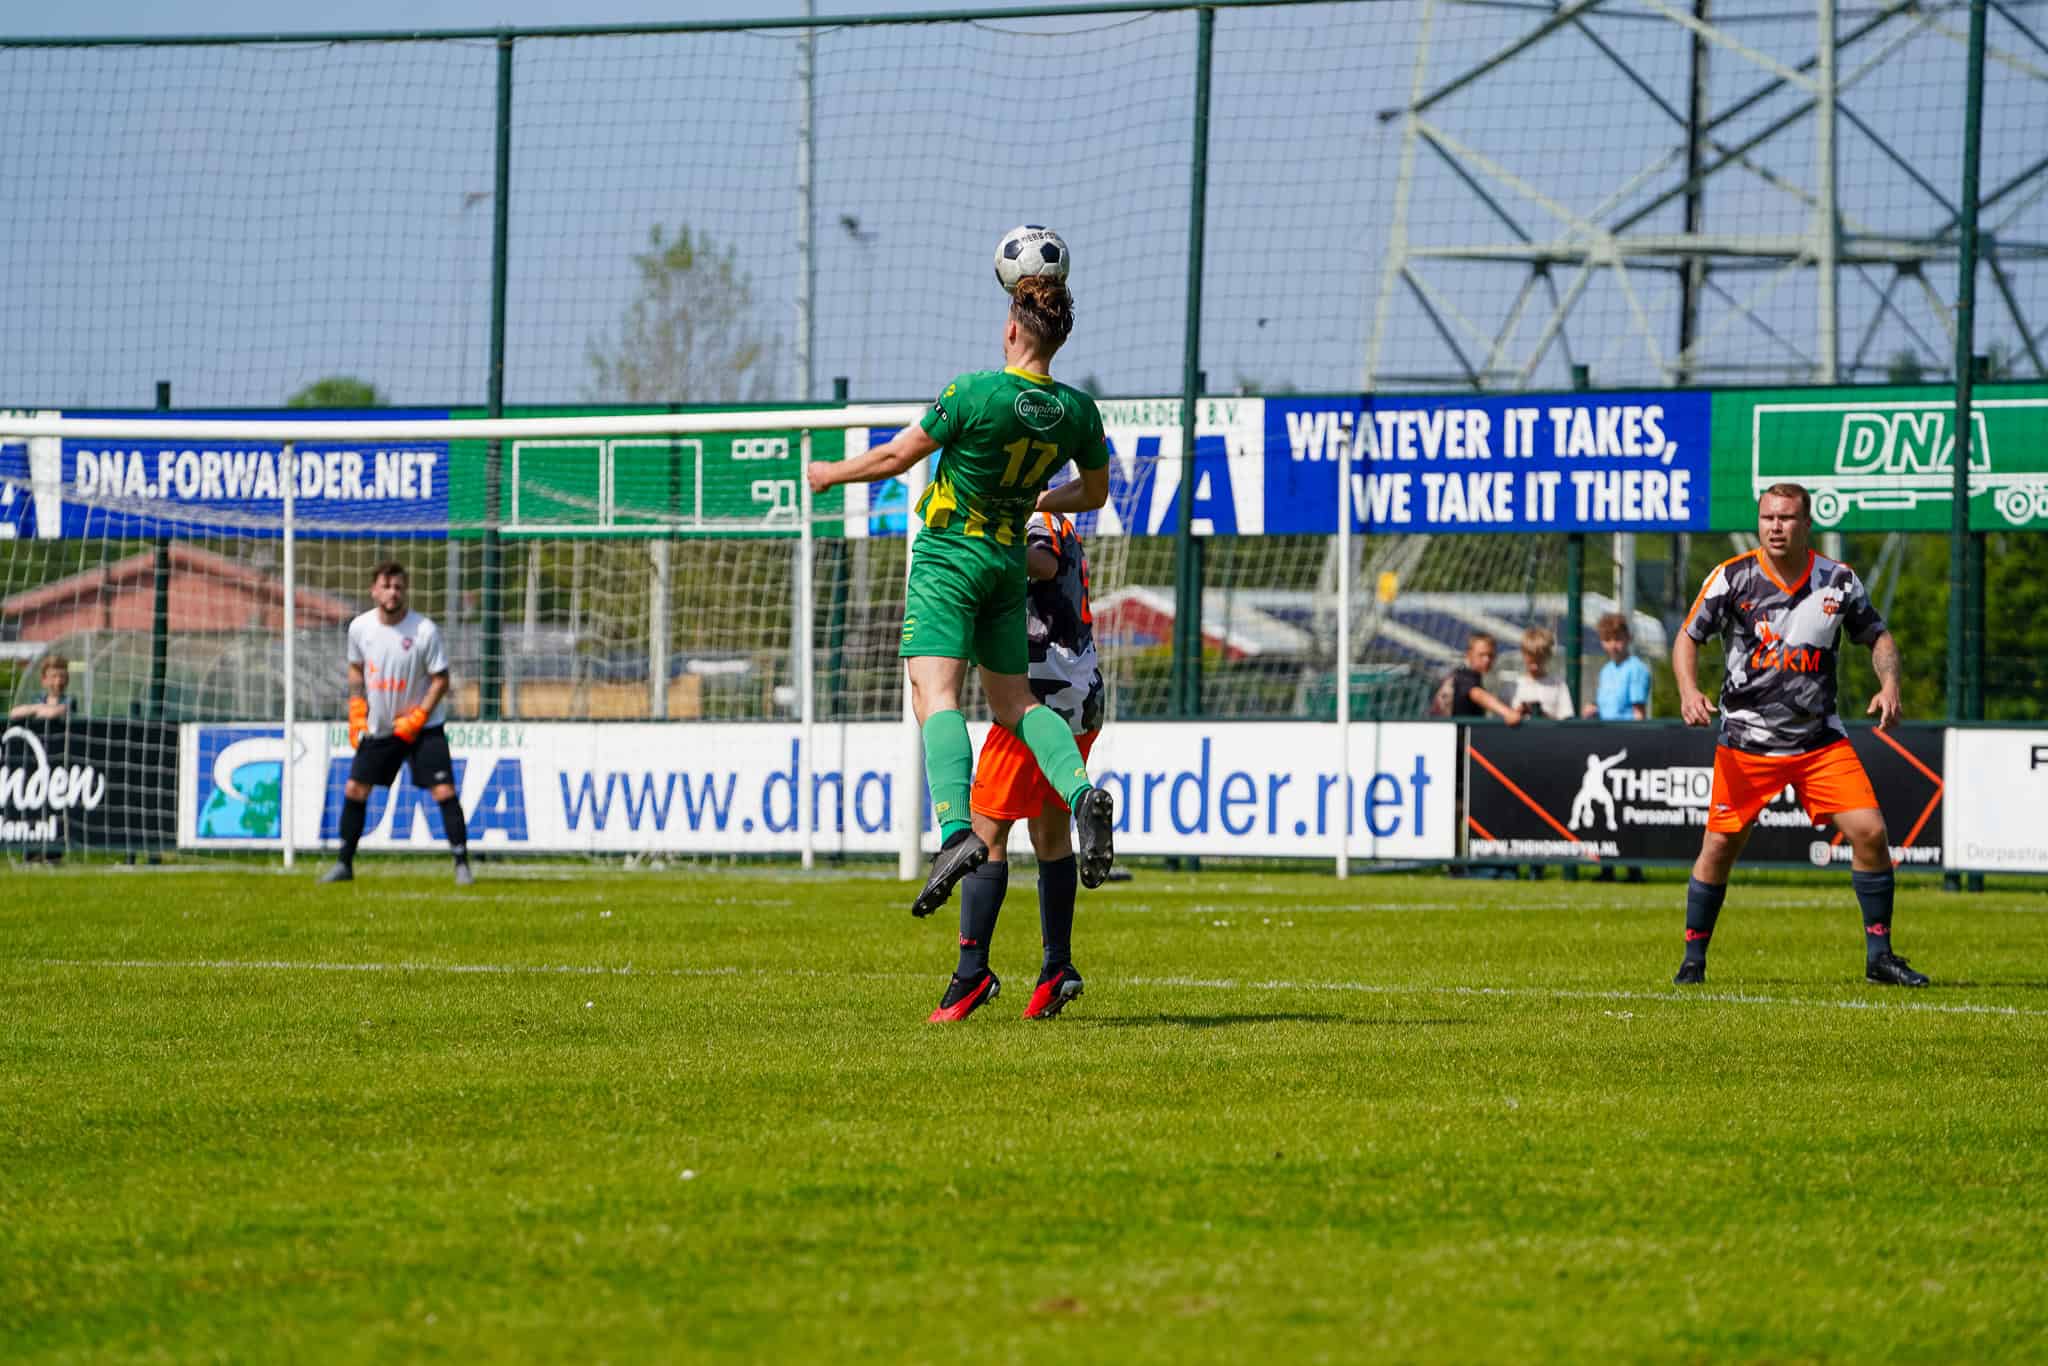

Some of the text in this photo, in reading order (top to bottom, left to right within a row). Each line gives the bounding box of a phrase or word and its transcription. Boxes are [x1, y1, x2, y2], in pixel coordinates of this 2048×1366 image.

[1286, 405, 1679, 465] WHATEVER IT TAKES,
[1834, 411, 1992, 475] DNA
[76, 450, 437, 500] DNA.FORWARDER.NET
[1000, 437, 1059, 488] 17
[1350, 470, 1692, 524] WE TAKE IT THERE
[1623, 806, 1685, 825] Personal
